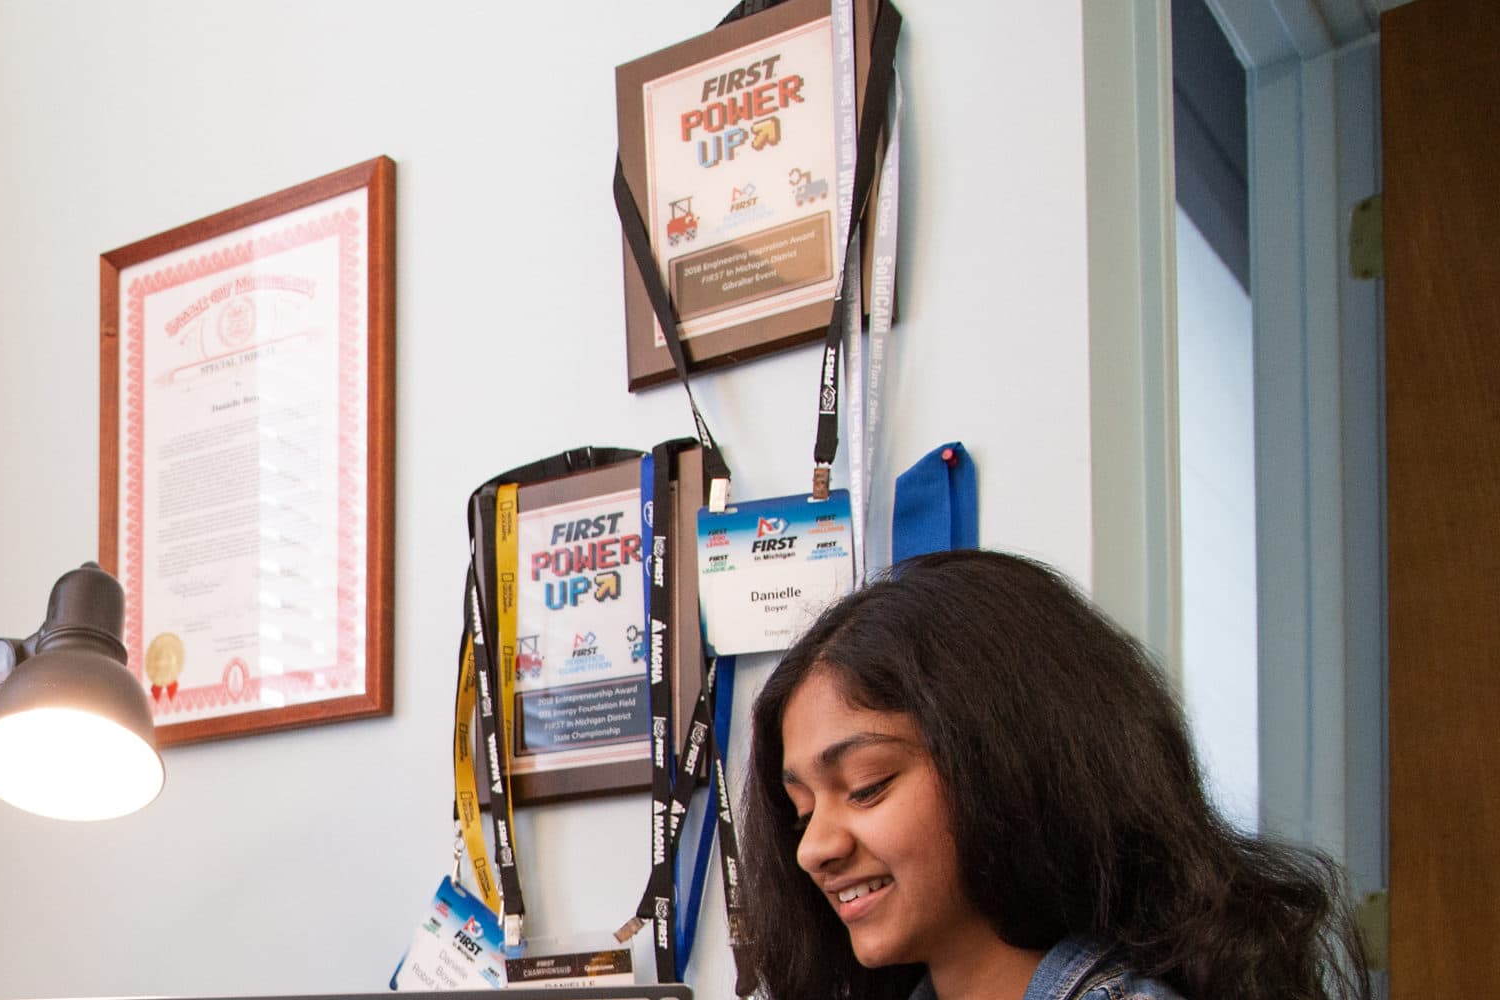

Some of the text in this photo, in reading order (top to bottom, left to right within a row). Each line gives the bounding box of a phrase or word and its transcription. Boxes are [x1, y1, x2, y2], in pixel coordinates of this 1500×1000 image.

[701, 54, 781, 103] FIRST
[681, 74, 805, 142] POWER
[698, 127, 749, 168] UP
[730, 196, 759, 213] FIRST
[703, 250, 748, 271] Engineering
[748, 239, 789, 257] Inspiration
[789, 230, 816, 245] Award
[702, 272, 725, 286] FIRST
[735, 258, 771, 275] Michigan
[771, 249, 798, 264] District
[755, 269, 778, 282] Event
[874, 256, 892, 333] SolidCAM
[824, 346, 837, 386] FIRST
[551, 512, 624, 545] FIRST
[531, 534, 642, 581] POWER
[709, 554, 729, 562] FIRST
[751, 536, 798, 553] FIRST
[763, 551, 796, 561] Michigan
[816, 541, 837, 549] FIRST
[654, 556, 664, 588] FIRST
[545, 576, 592, 610] UP
[751, 587, 802, 602] Danielle
[764, 604, 788, 613] Boyer
[572, 646, 599, 658] FIRST
[651, 638, 664, 685] MAGNA
[553, 707, 578, 719] Energy
[578, 701, 618, 713] Foundation
[618, 697, 636, 707] Field
[555, 689, 614, 705] Entrepreneurship
[614, 685, 638, 696] Award
[571, 726, 621, 740] Championship
[574, 716, 606, 727] Michigan
[607, 712, 632, 722] District
[654, 739, 665, 769] FIRST
[684, 745, 700, 776] FIRST
[653, 814, 665, 866] MAGNA
[454, 930, 483, 956] FIRST
[656, 920, 668, 950] FIRST
[523, 966, 571, 977] CHAMPIONSHIP
[536, 959, 556, 967] FIRST
